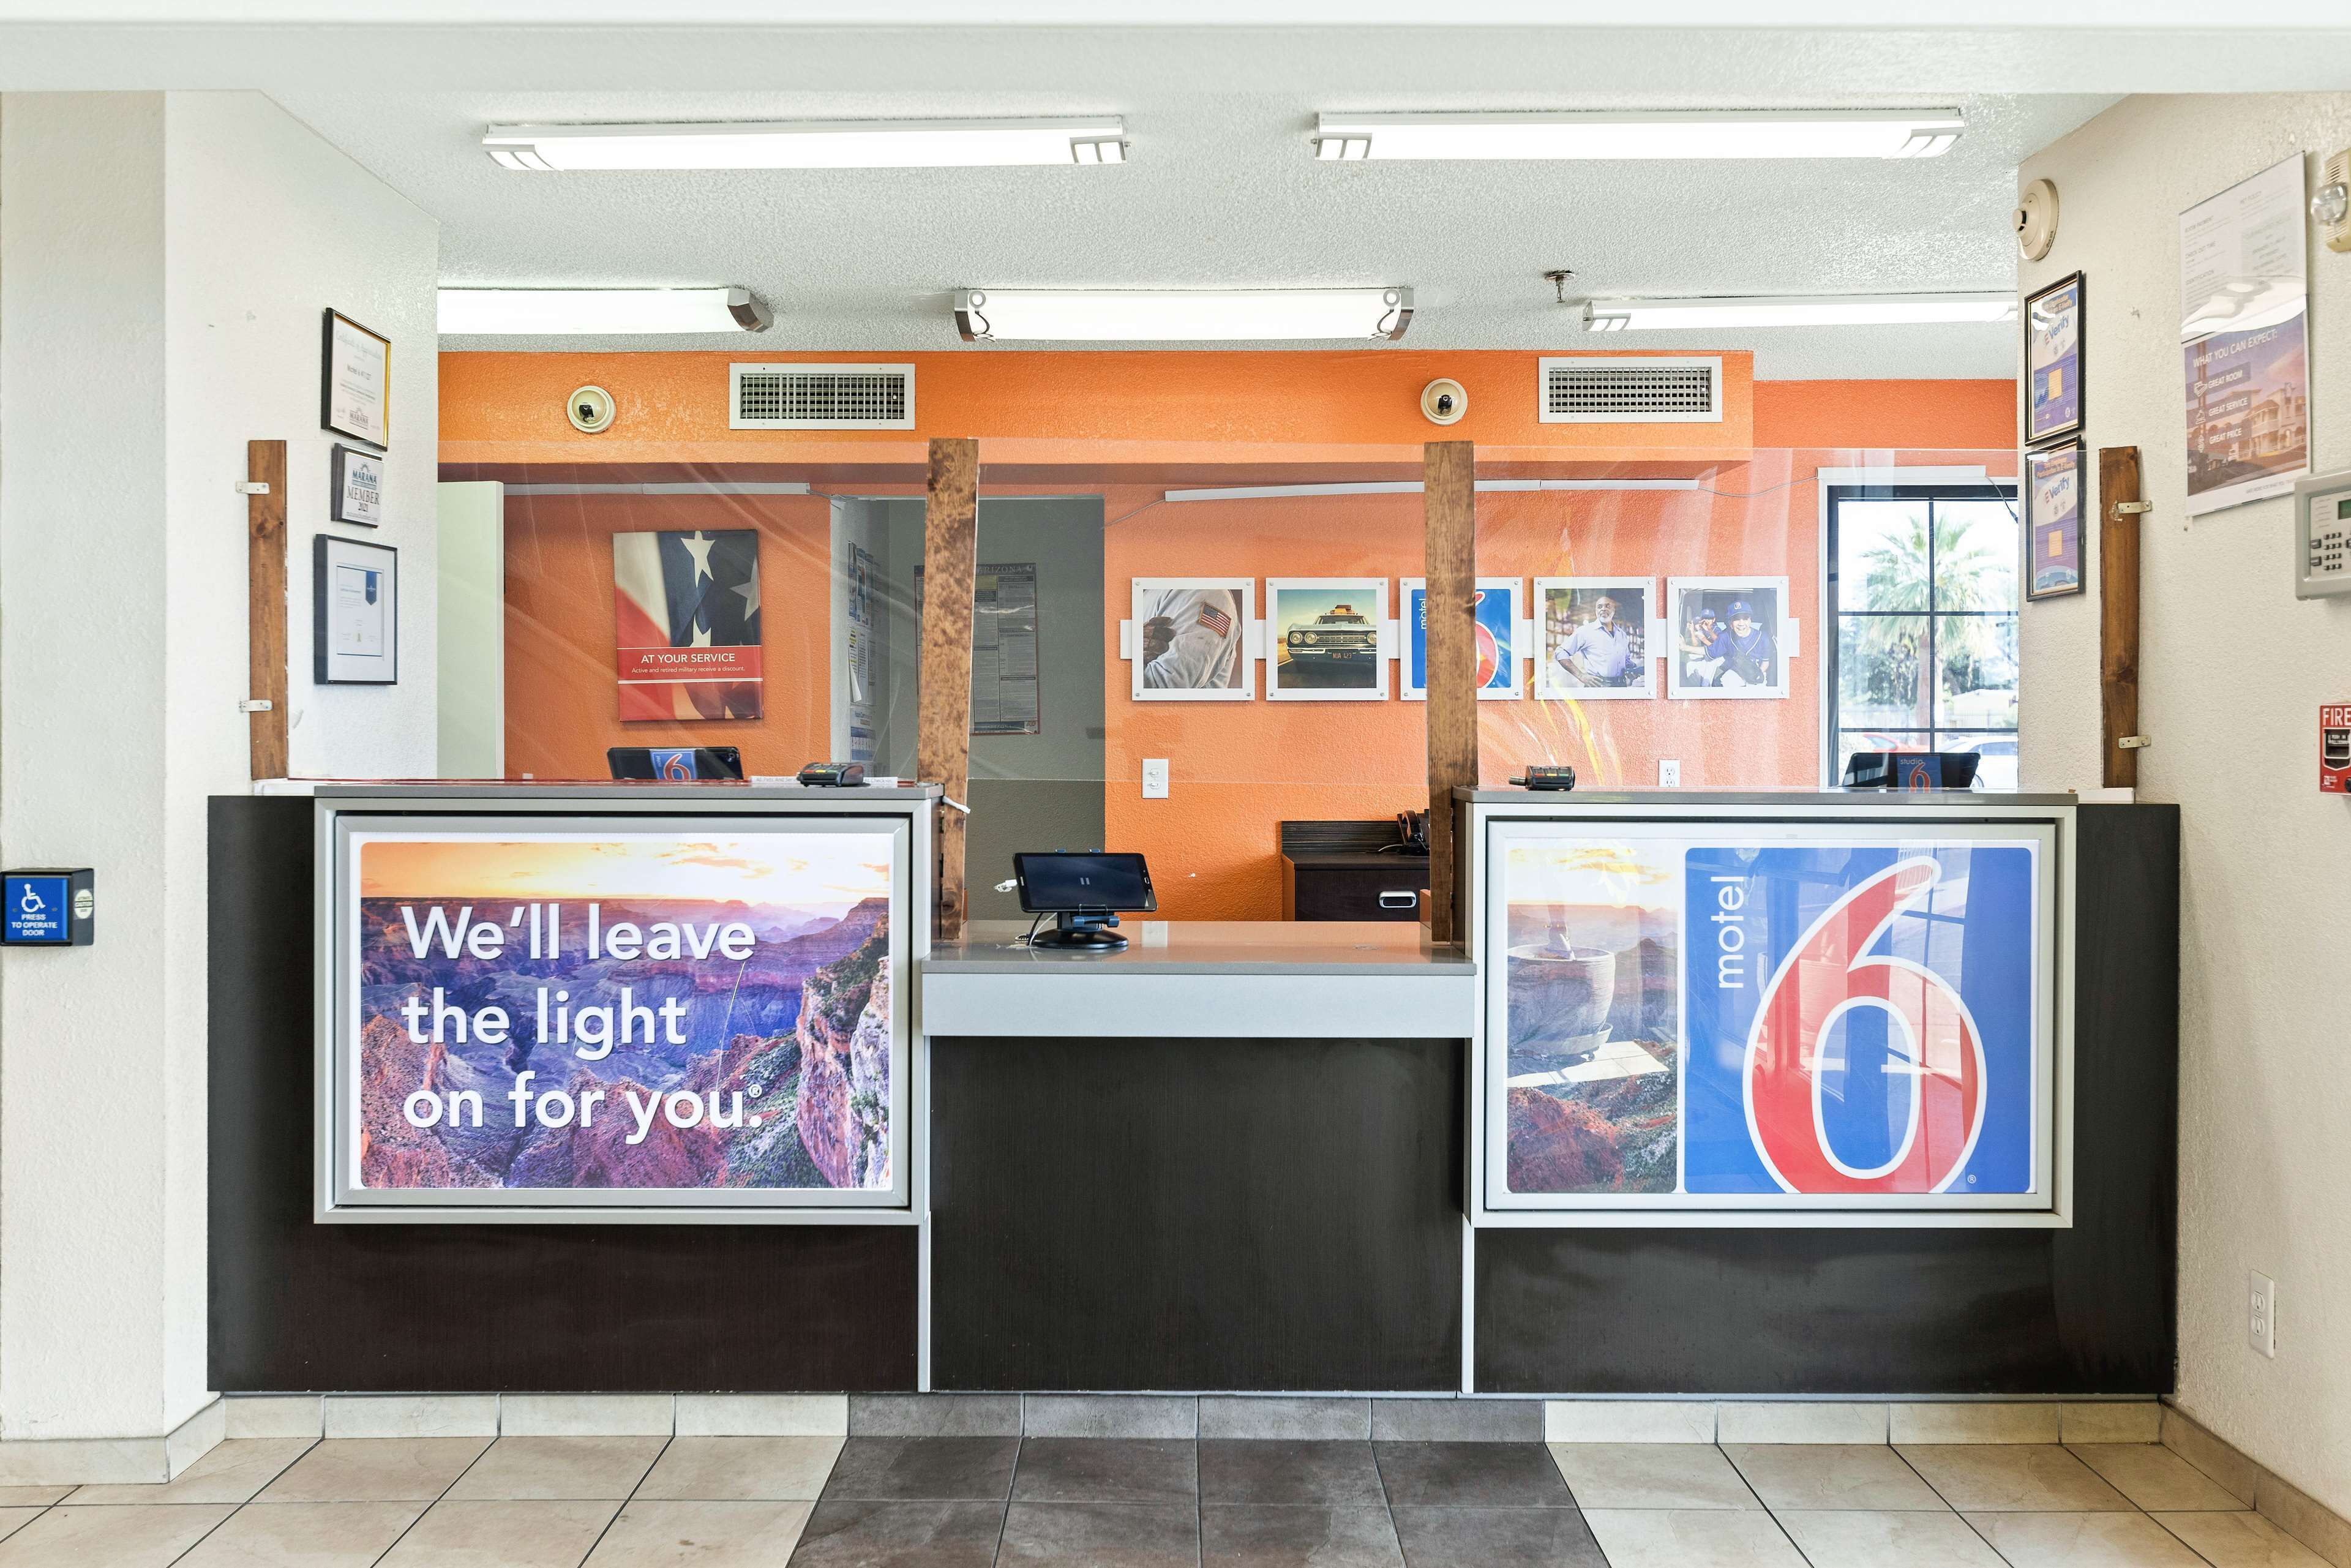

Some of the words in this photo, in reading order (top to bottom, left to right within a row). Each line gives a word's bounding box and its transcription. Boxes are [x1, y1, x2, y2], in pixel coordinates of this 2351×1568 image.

[2192, 352, 2213, 367] WHAT
[2214, 346, 2229, 359] YOU
[2230, 341, 2247, 354] CAN
[2248, 329, 2278, 348] EXPECT:
[2208, 376, 2225, 389] GREAT
[2225, 370, 2243, 383] ROOM
[2208, 404, 2225, 417] GREAT
[2225, 397, 2248, 411] SERVICE
[2209, 432, 2226, 445] GREAT
[2227, 427, 2243, 440] PRICE
[347, 486, 379, 505] MEMBER
[641, 655, 654, 664] AT
[658, 654, 688, 663] YOUR
[691, 653, 735, 662] SERVICE
[2322, 707, 2351, 726] FIRE
[664, 754, 691, 781] 6
[1910, 762, 1930, 788] 6
[400, 903, 560, 961] We'll
[589, 903, 756, 961] leave
[1711, 876, 1744, 989] motel
[401, 986, 510, 1044] the
[536, 986, 687, 1061] light
[1743, 855, 1987, 1193] 6
[403, 1090, 484, 1128] on
[508, 1070, 606, 1128] for
